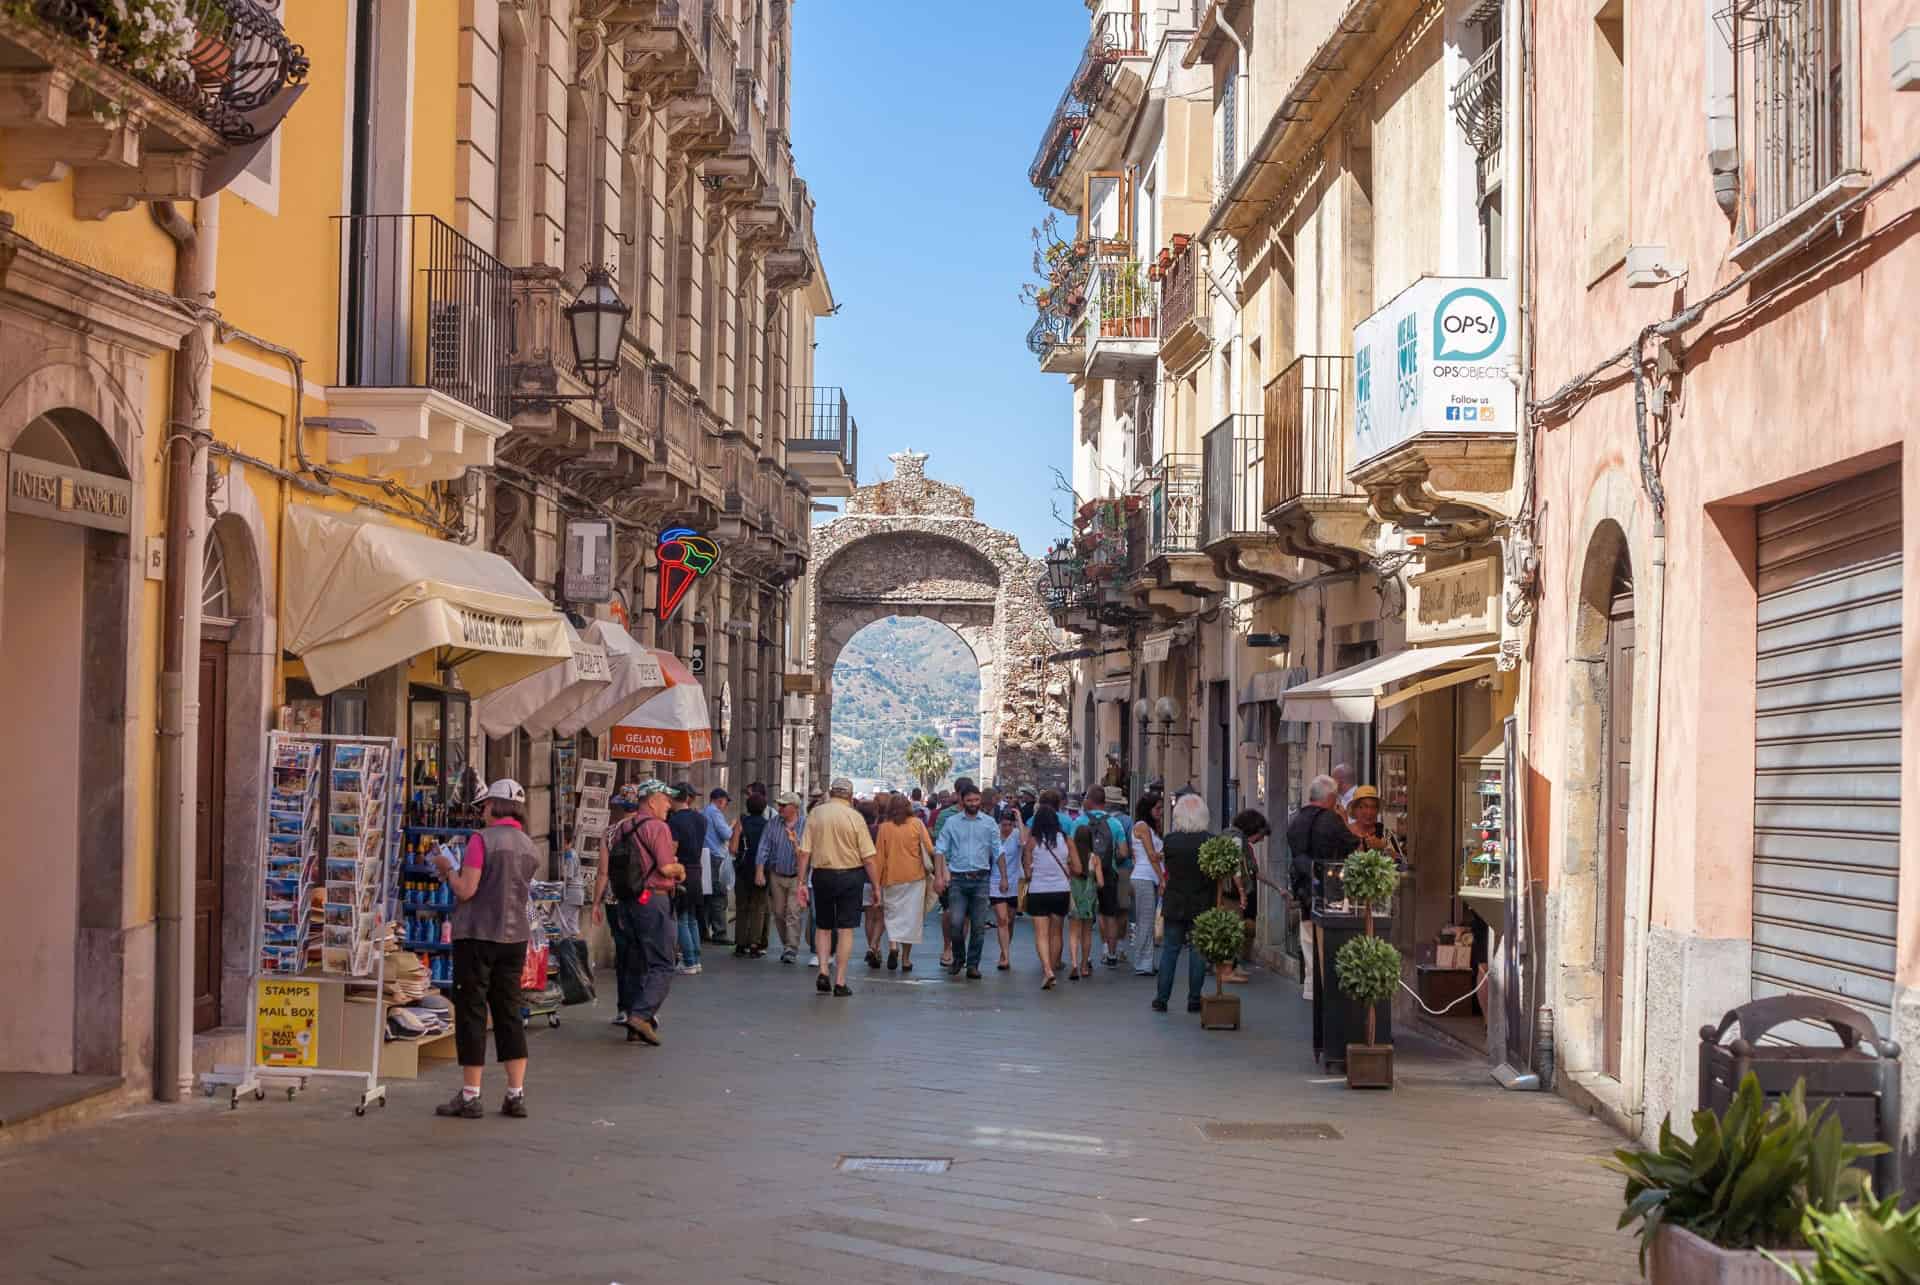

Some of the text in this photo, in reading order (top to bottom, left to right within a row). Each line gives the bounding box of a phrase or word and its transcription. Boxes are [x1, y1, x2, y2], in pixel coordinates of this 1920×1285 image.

[1443, 315, 1495, 334] OPS!
[1433, 366, 1508, 379] OPSOBJECTS
[1451, 394, 1489, 404] Follow us
[14, 470, 128, 518] INTESA SANPAOLO
[572, 523, 608, 576] T
[152, 550, 161, 568] 15
[625, 733, 664, 745] GELATO
[611, 743, 676, 757] ARTIGIANALE
[265, 986, 310, 996] STAMPS
[259, 1007, 315, 1017] MAIL BOX
[271, 1031, 297, 1039] MAIL
